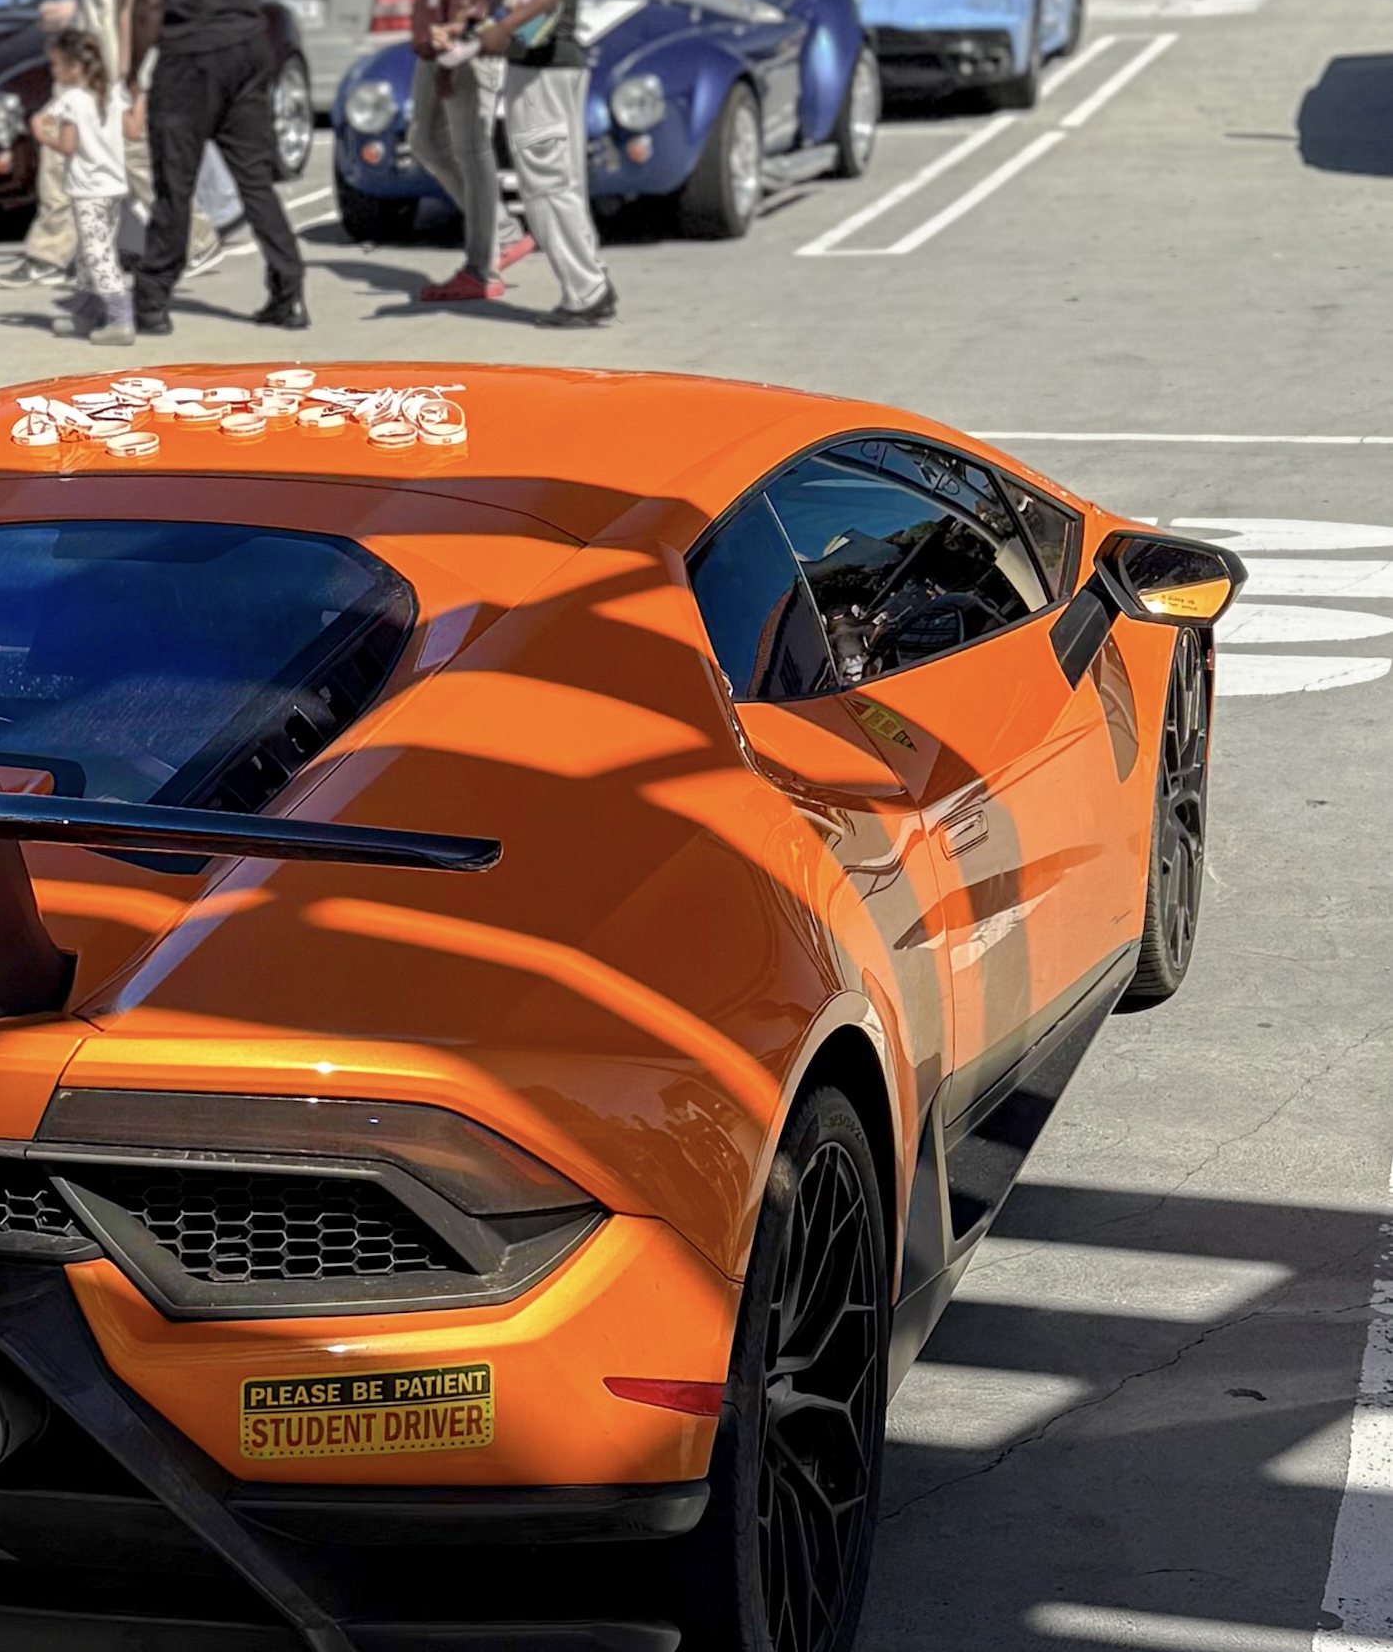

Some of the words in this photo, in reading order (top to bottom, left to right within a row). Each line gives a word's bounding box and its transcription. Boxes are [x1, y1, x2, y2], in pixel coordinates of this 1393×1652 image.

[250, 1383, 342, 1407] PLEASE
[352, 1380, 384, 1402] BE
[394, 1370, 487, 1399] PATIENT
[251, 1412, 377, 1449] STUDENT
[383, 1404, 484, 1443] DRIVER
